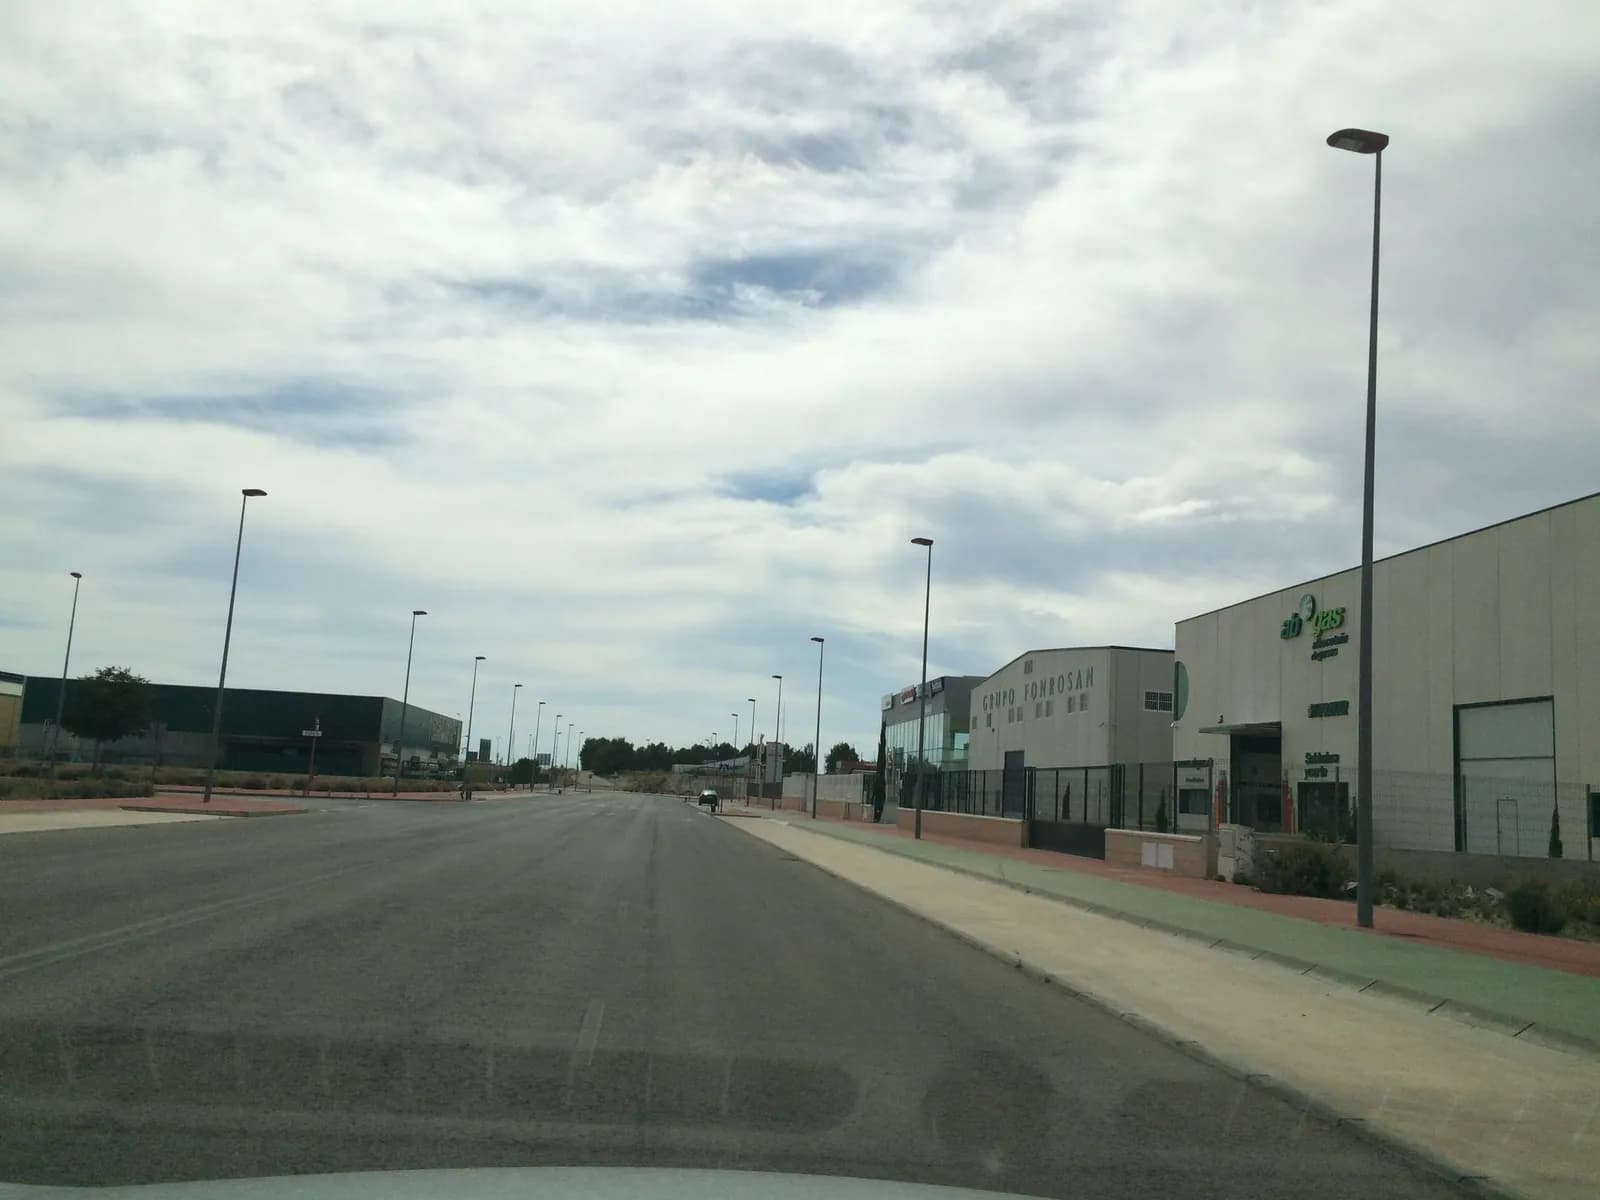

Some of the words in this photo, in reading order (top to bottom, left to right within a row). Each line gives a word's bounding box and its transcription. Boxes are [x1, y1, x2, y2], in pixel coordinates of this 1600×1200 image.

[1312, 607, 1346, 637] gas
[983, 688, 1015, 711] GRUPO
[1024, 666, 1094, 701] FONROSAN
